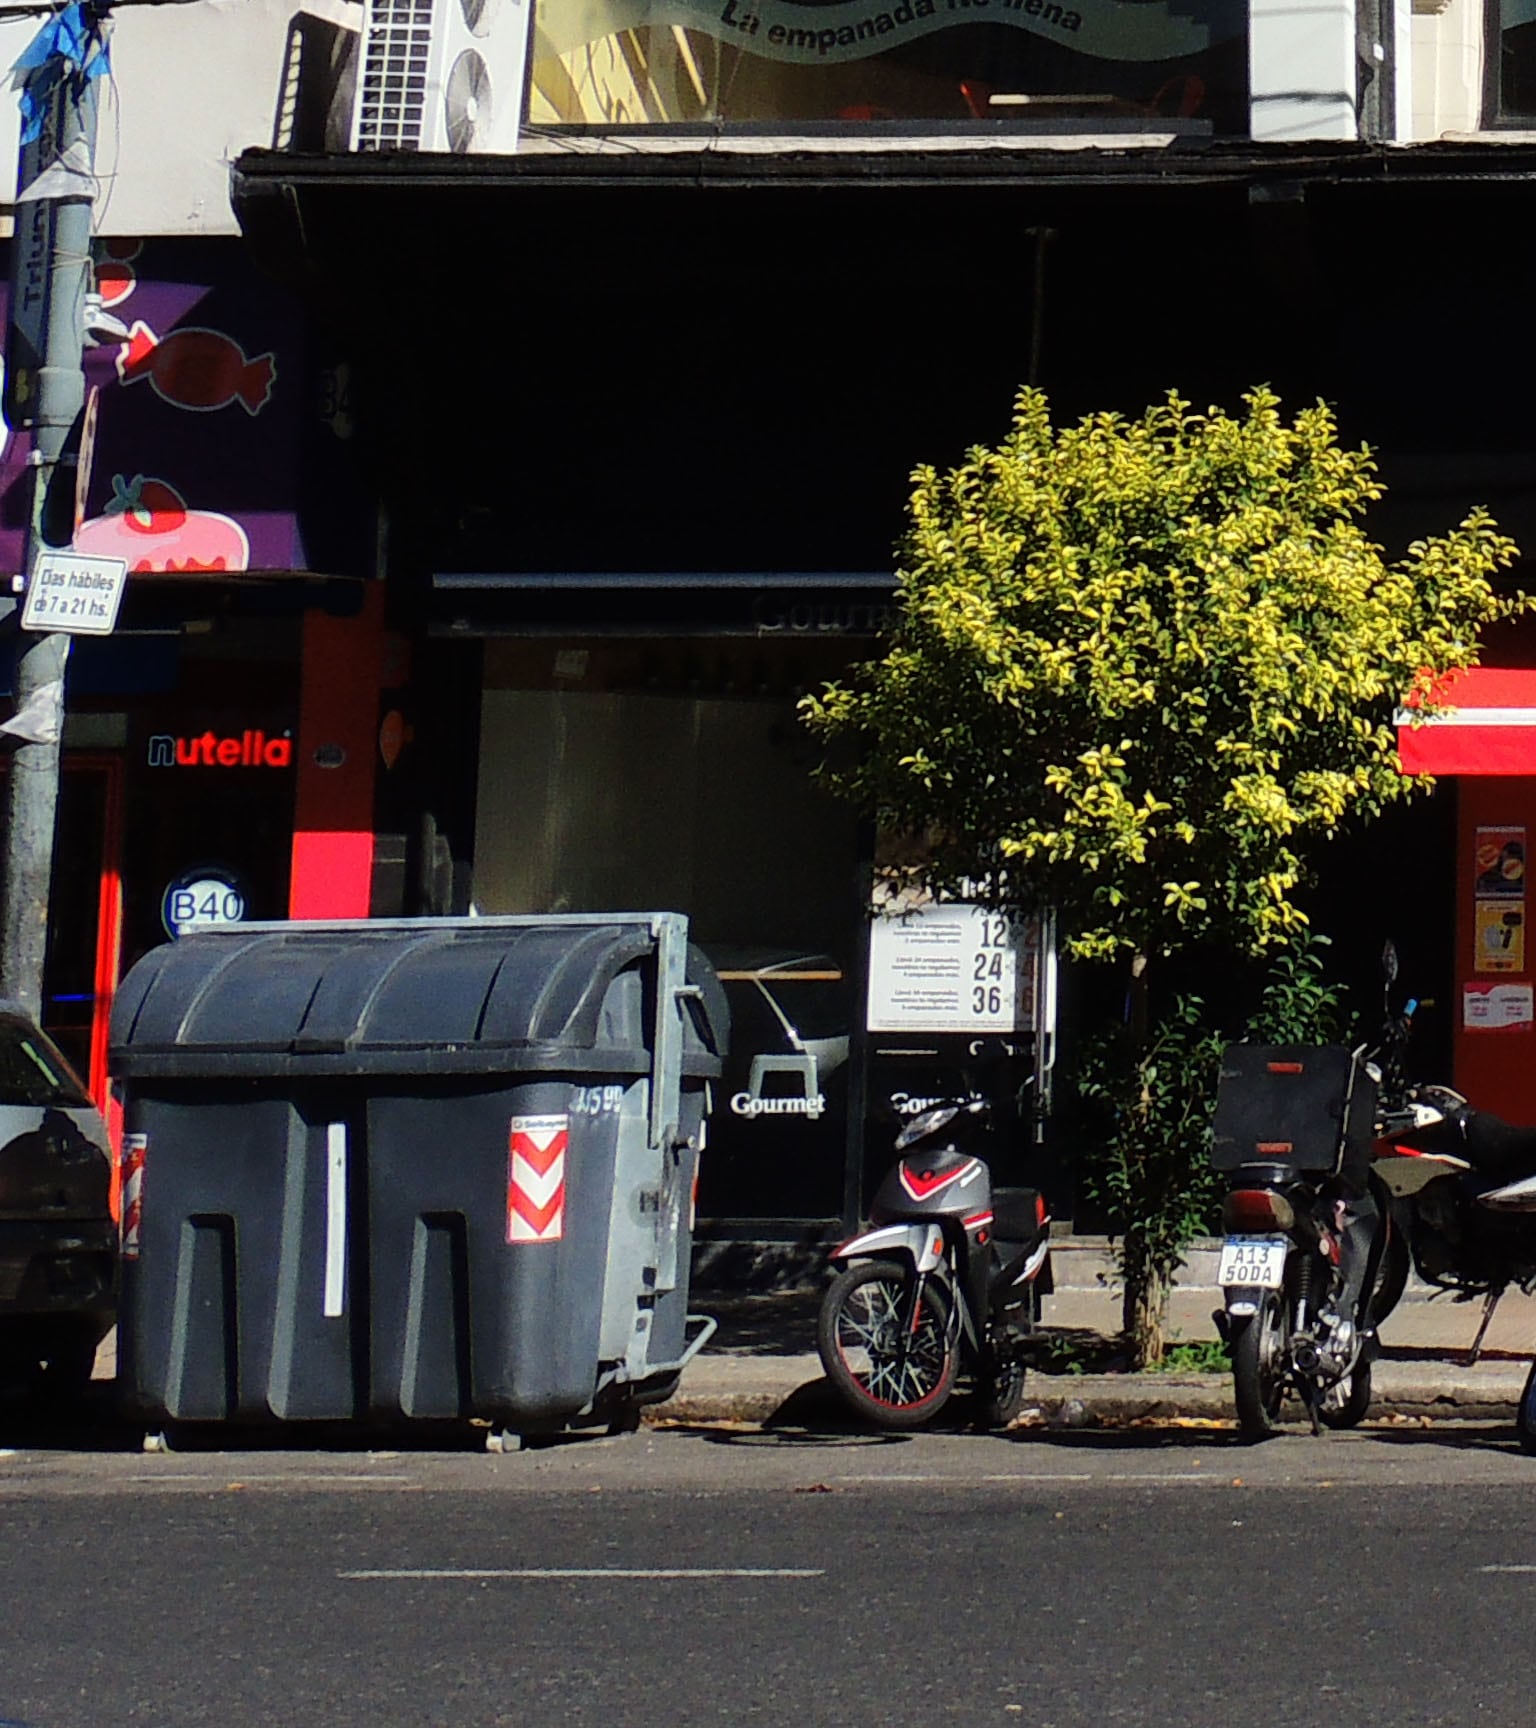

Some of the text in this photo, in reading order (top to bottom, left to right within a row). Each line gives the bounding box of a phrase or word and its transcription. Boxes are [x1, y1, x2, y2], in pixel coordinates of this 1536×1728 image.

[68, 571, 115, 591] hábiles
[50, 596, 59, 612] 7
[60, 600, 69, 613] a
[70, 598, 87, 615] 21
[88, 598, 109, 617] hs.
[148, 729, 292, 766] nutella
[173, 891, 243, 921] B40
[981, 918, 1006, 948] 12
[974, 952, 1003, 982] 24
[972, 986, 1001, 1014] 36
[729, 1092, 826, 1114] Gourmet
[1234, 1247, 1270, 1265] A13
